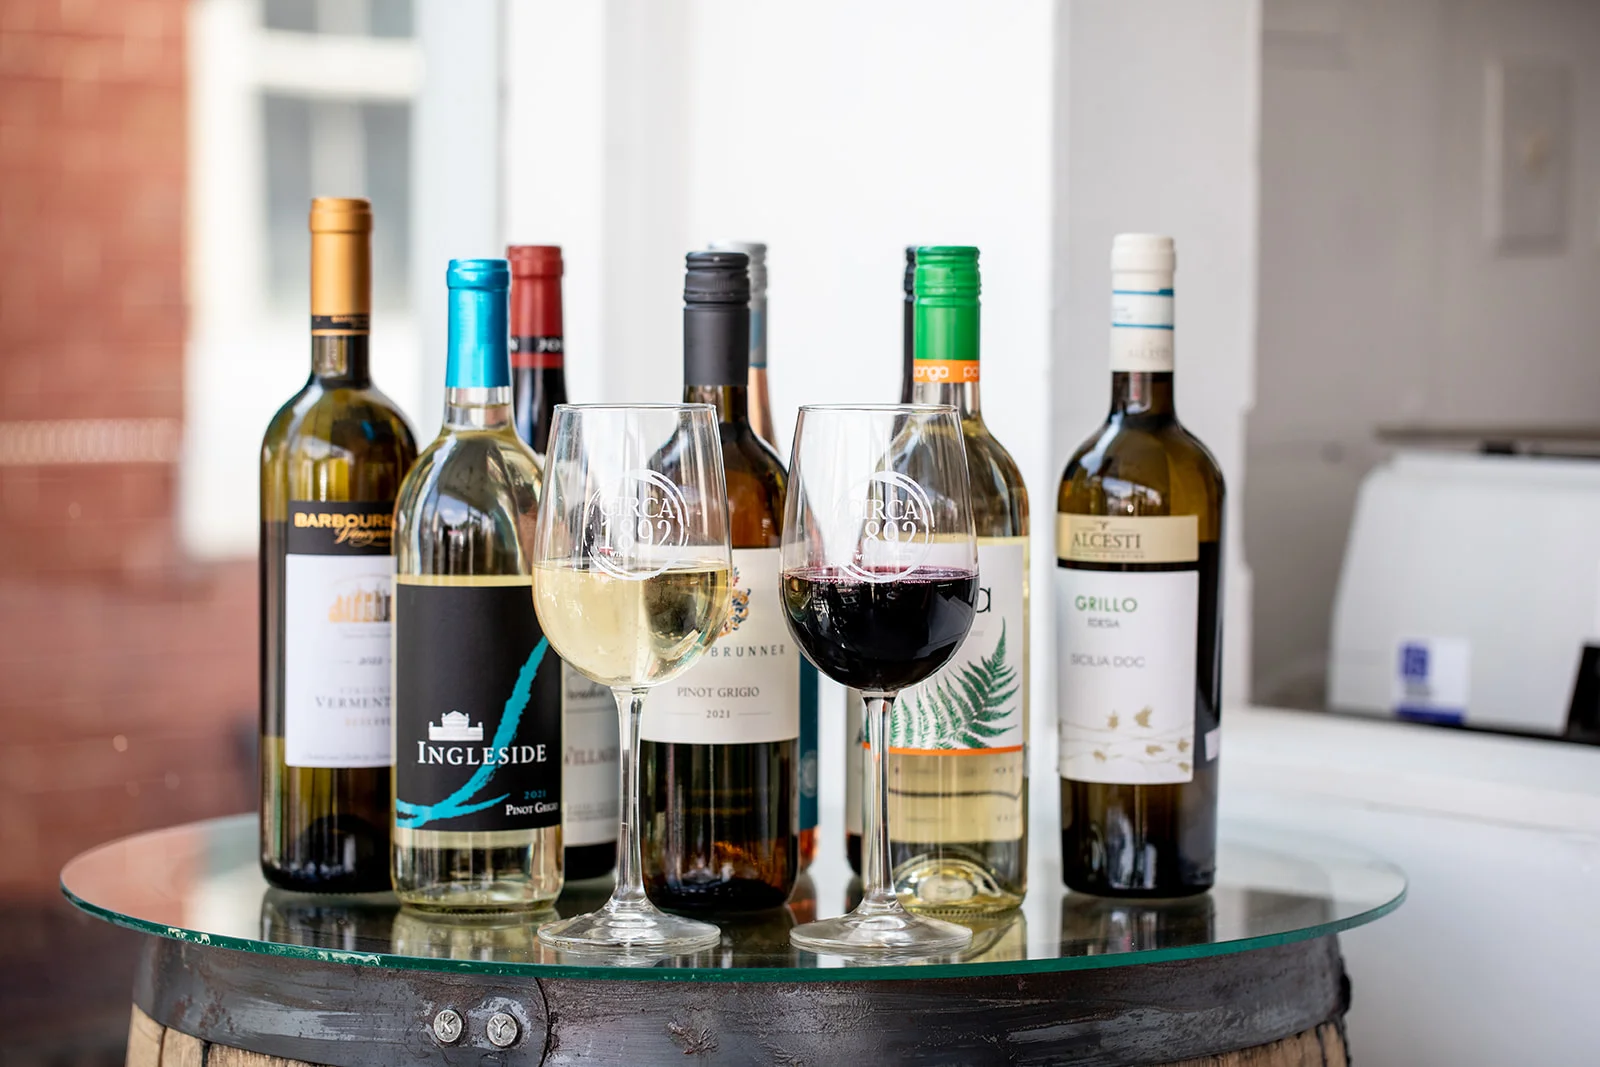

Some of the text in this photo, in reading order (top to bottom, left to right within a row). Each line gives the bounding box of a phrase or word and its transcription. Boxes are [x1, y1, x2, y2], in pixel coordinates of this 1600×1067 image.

[600, 496, 676, 519] CIRCA
[600, 519, 673, 550] 1892
[1072, 532, 1141, 549] ALCESTI
[1075, 595, 1138, 613] GRILLO
[711, 644, 785, 657] BRUNNER
[1113, 656, 1145, 668] DOC
[677, 686, 760, 698] PINOT GRIGIO
[706, 710, 732, 718] 2021
[417, 740, 548, 766] INGLESIDE
[523, 790, 547, 800] 2021
[505, 804, 534, 816] PINOT
